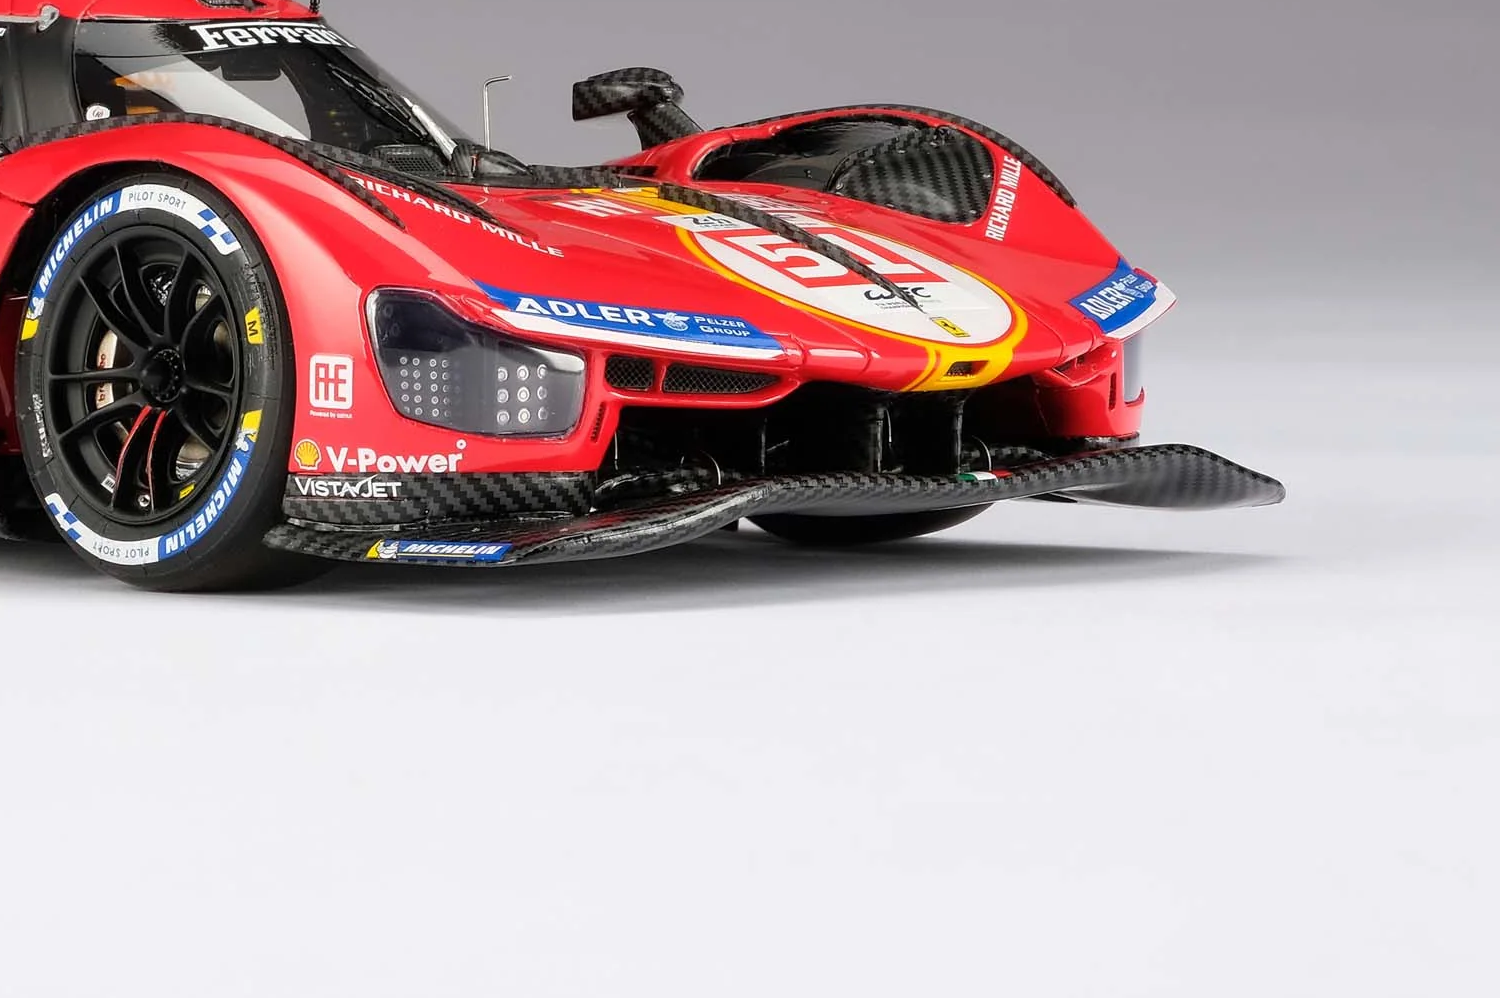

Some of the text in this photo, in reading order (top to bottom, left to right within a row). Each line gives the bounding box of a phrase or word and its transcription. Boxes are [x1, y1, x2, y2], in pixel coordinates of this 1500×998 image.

[128, 191, 187, 210] PILOT SPORT
[985, 154, 1022, 241] RICHARD MILLE
[38, 197, 114, 293] MICHELIN
[477, 220, 565, 258] MILLE
[723, 233, 925, 280] 51
[515, 296, 657, 328] ADLER
[1079, 286, 1136, 321] ADLER
[247, 320, 259, 337] M
[693, 315, 746, 329] PELZER
[699, 325, 751, 338] GROUP
[326, 445, 464, 473] V-Power
[164, 457, 244, 555] MICHELIN
[92, 541, 150, 559] PILOT SPORT
[402, 543, 504, 555] MICHELIN
